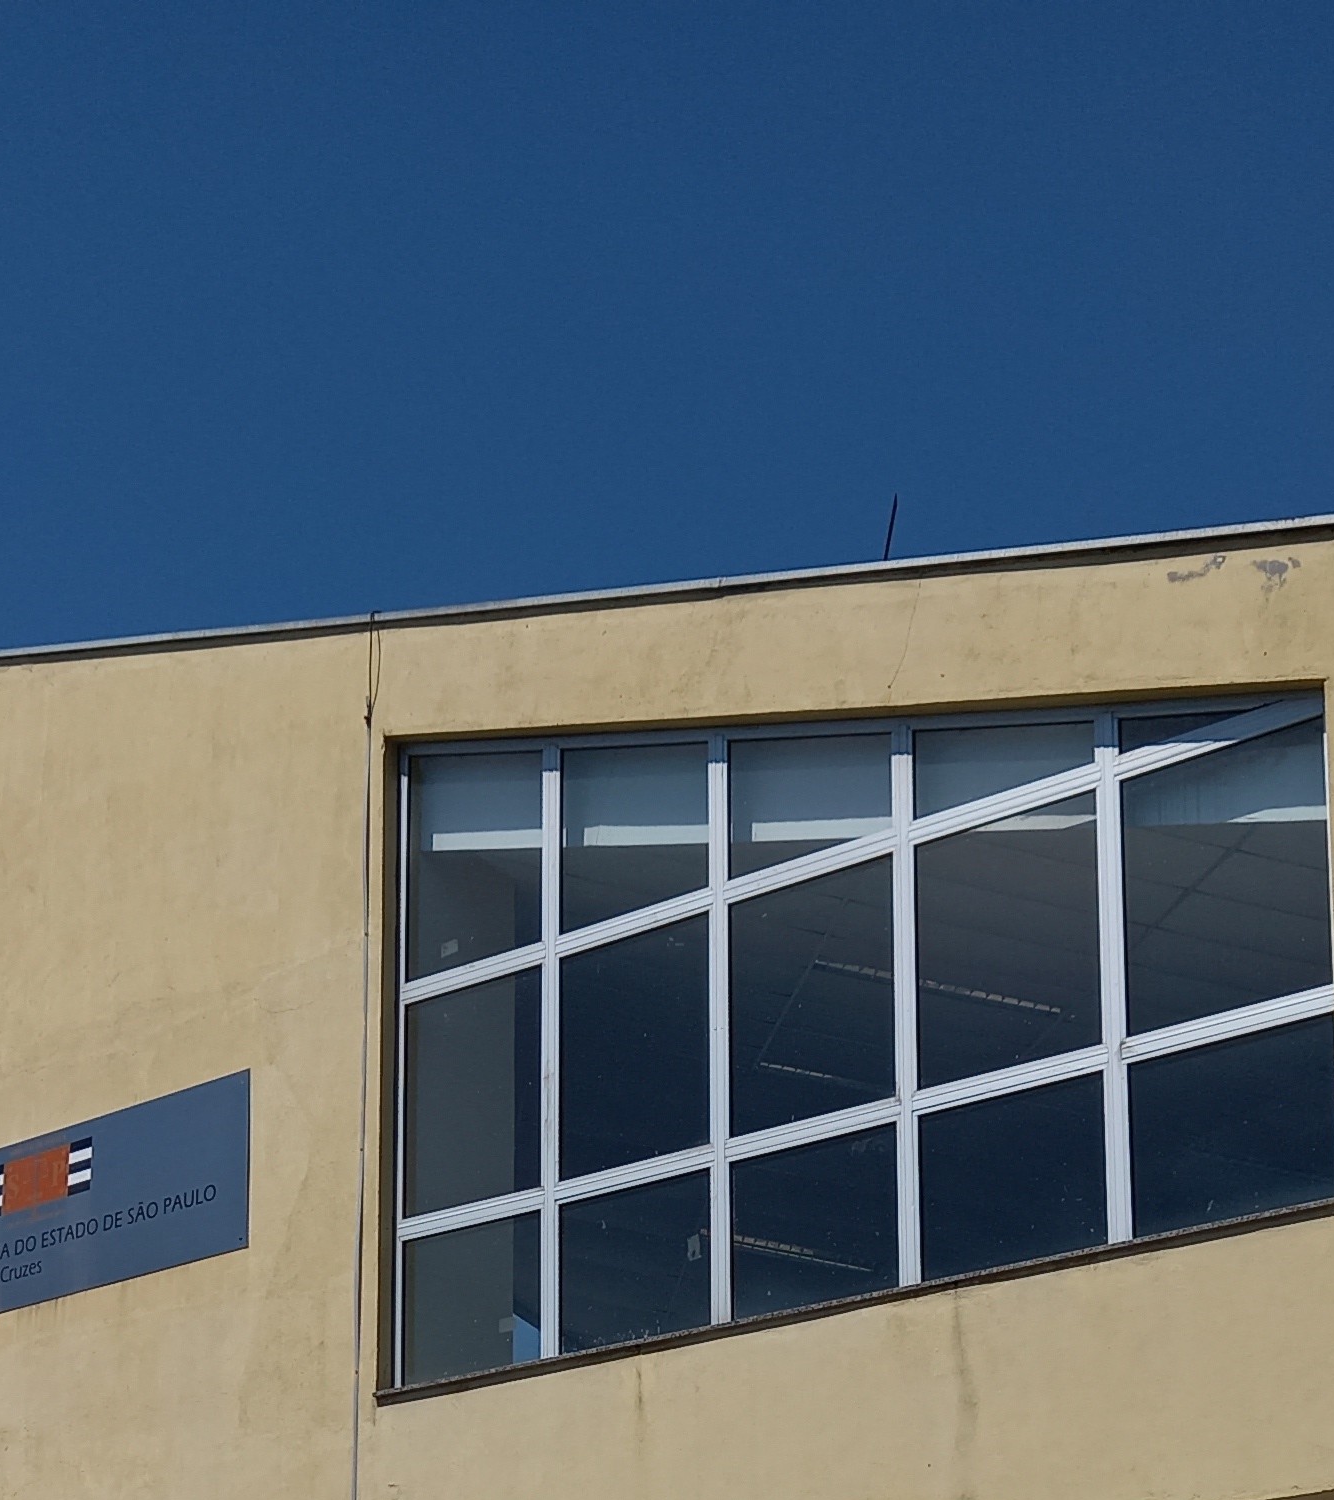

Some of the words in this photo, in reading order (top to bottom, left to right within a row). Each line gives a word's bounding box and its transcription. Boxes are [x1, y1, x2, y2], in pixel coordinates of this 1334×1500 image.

[14, 1235, 37, 1256] DO
[41, 1218, 99, 1249] ESTADO
[103, 1211, 123, 1232] DE
[127, 1201, 159, 1225] SÃO
[163, 1184, 217, 1215] PAULO
[0, 1260, 42, 1283] Cruzes
